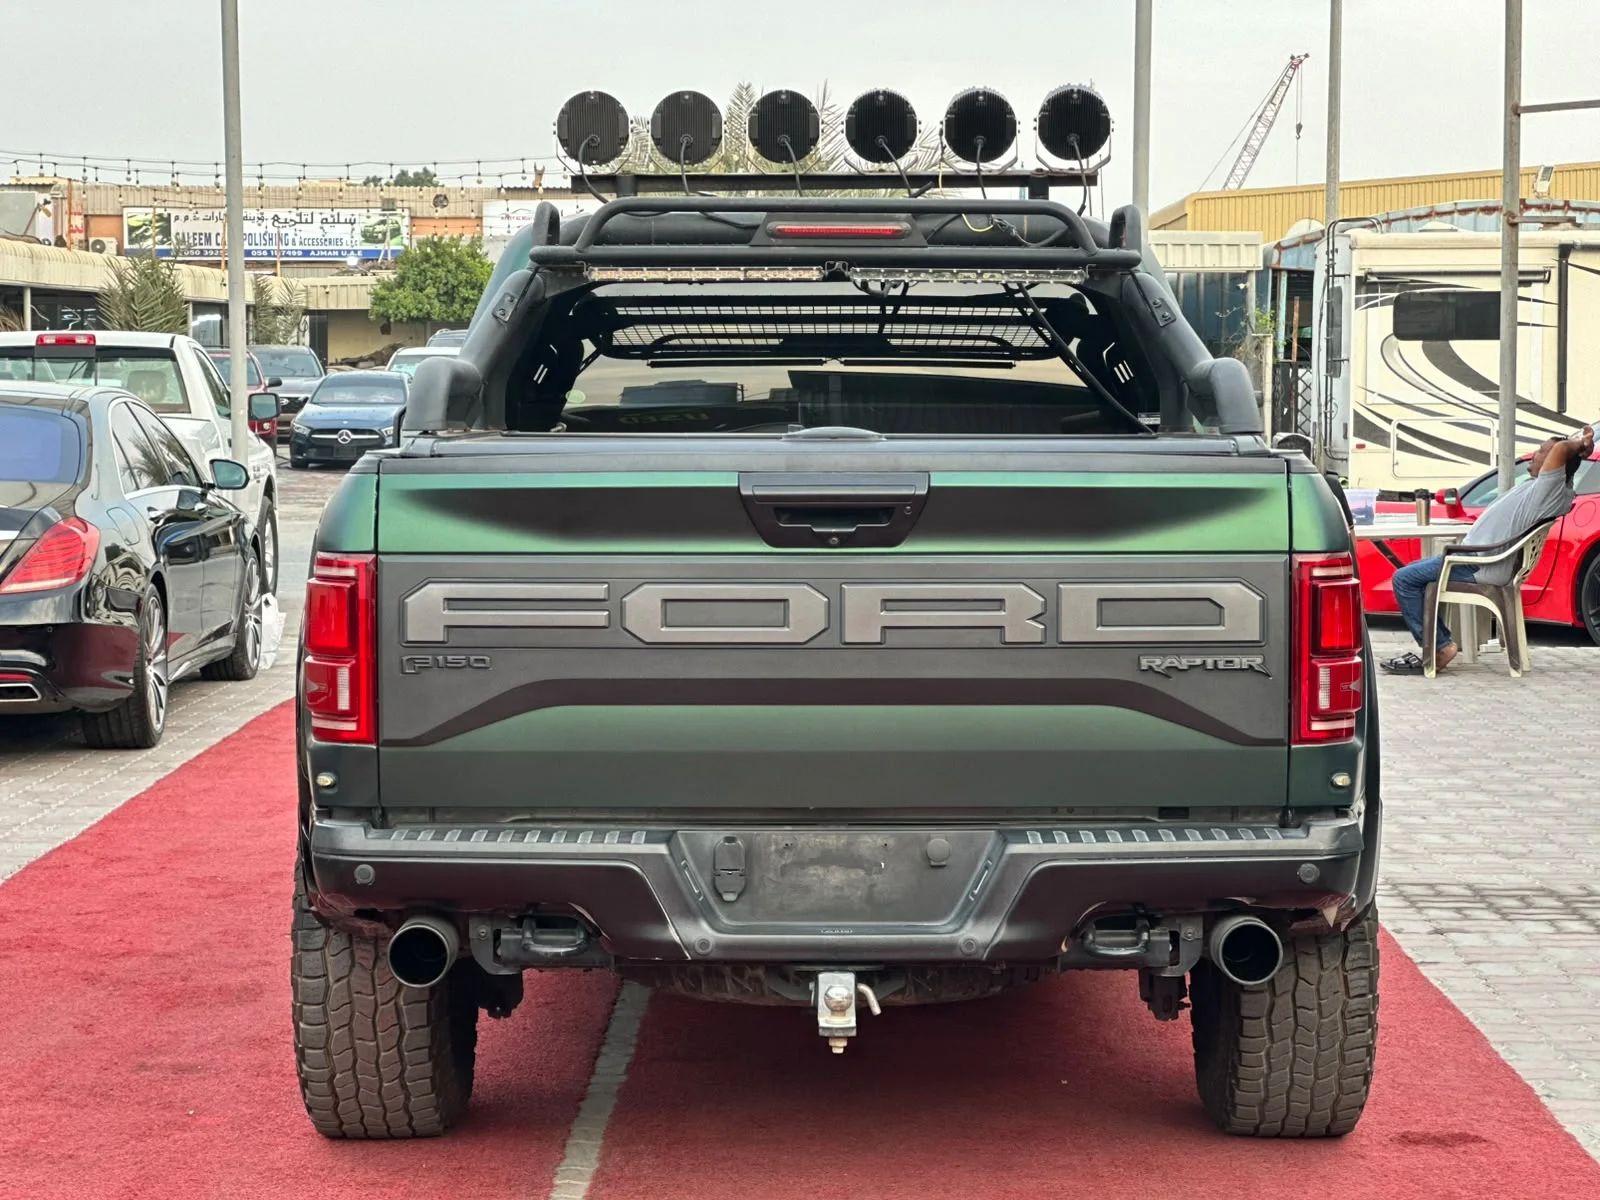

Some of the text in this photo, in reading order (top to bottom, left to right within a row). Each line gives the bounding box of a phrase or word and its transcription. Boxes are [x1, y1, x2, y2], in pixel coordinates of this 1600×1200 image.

[175, 232, 212, 247] SALEEM
[404, 579, 1263, 645] FORD
[1138, 655, 1272, 678] RAPTOR
